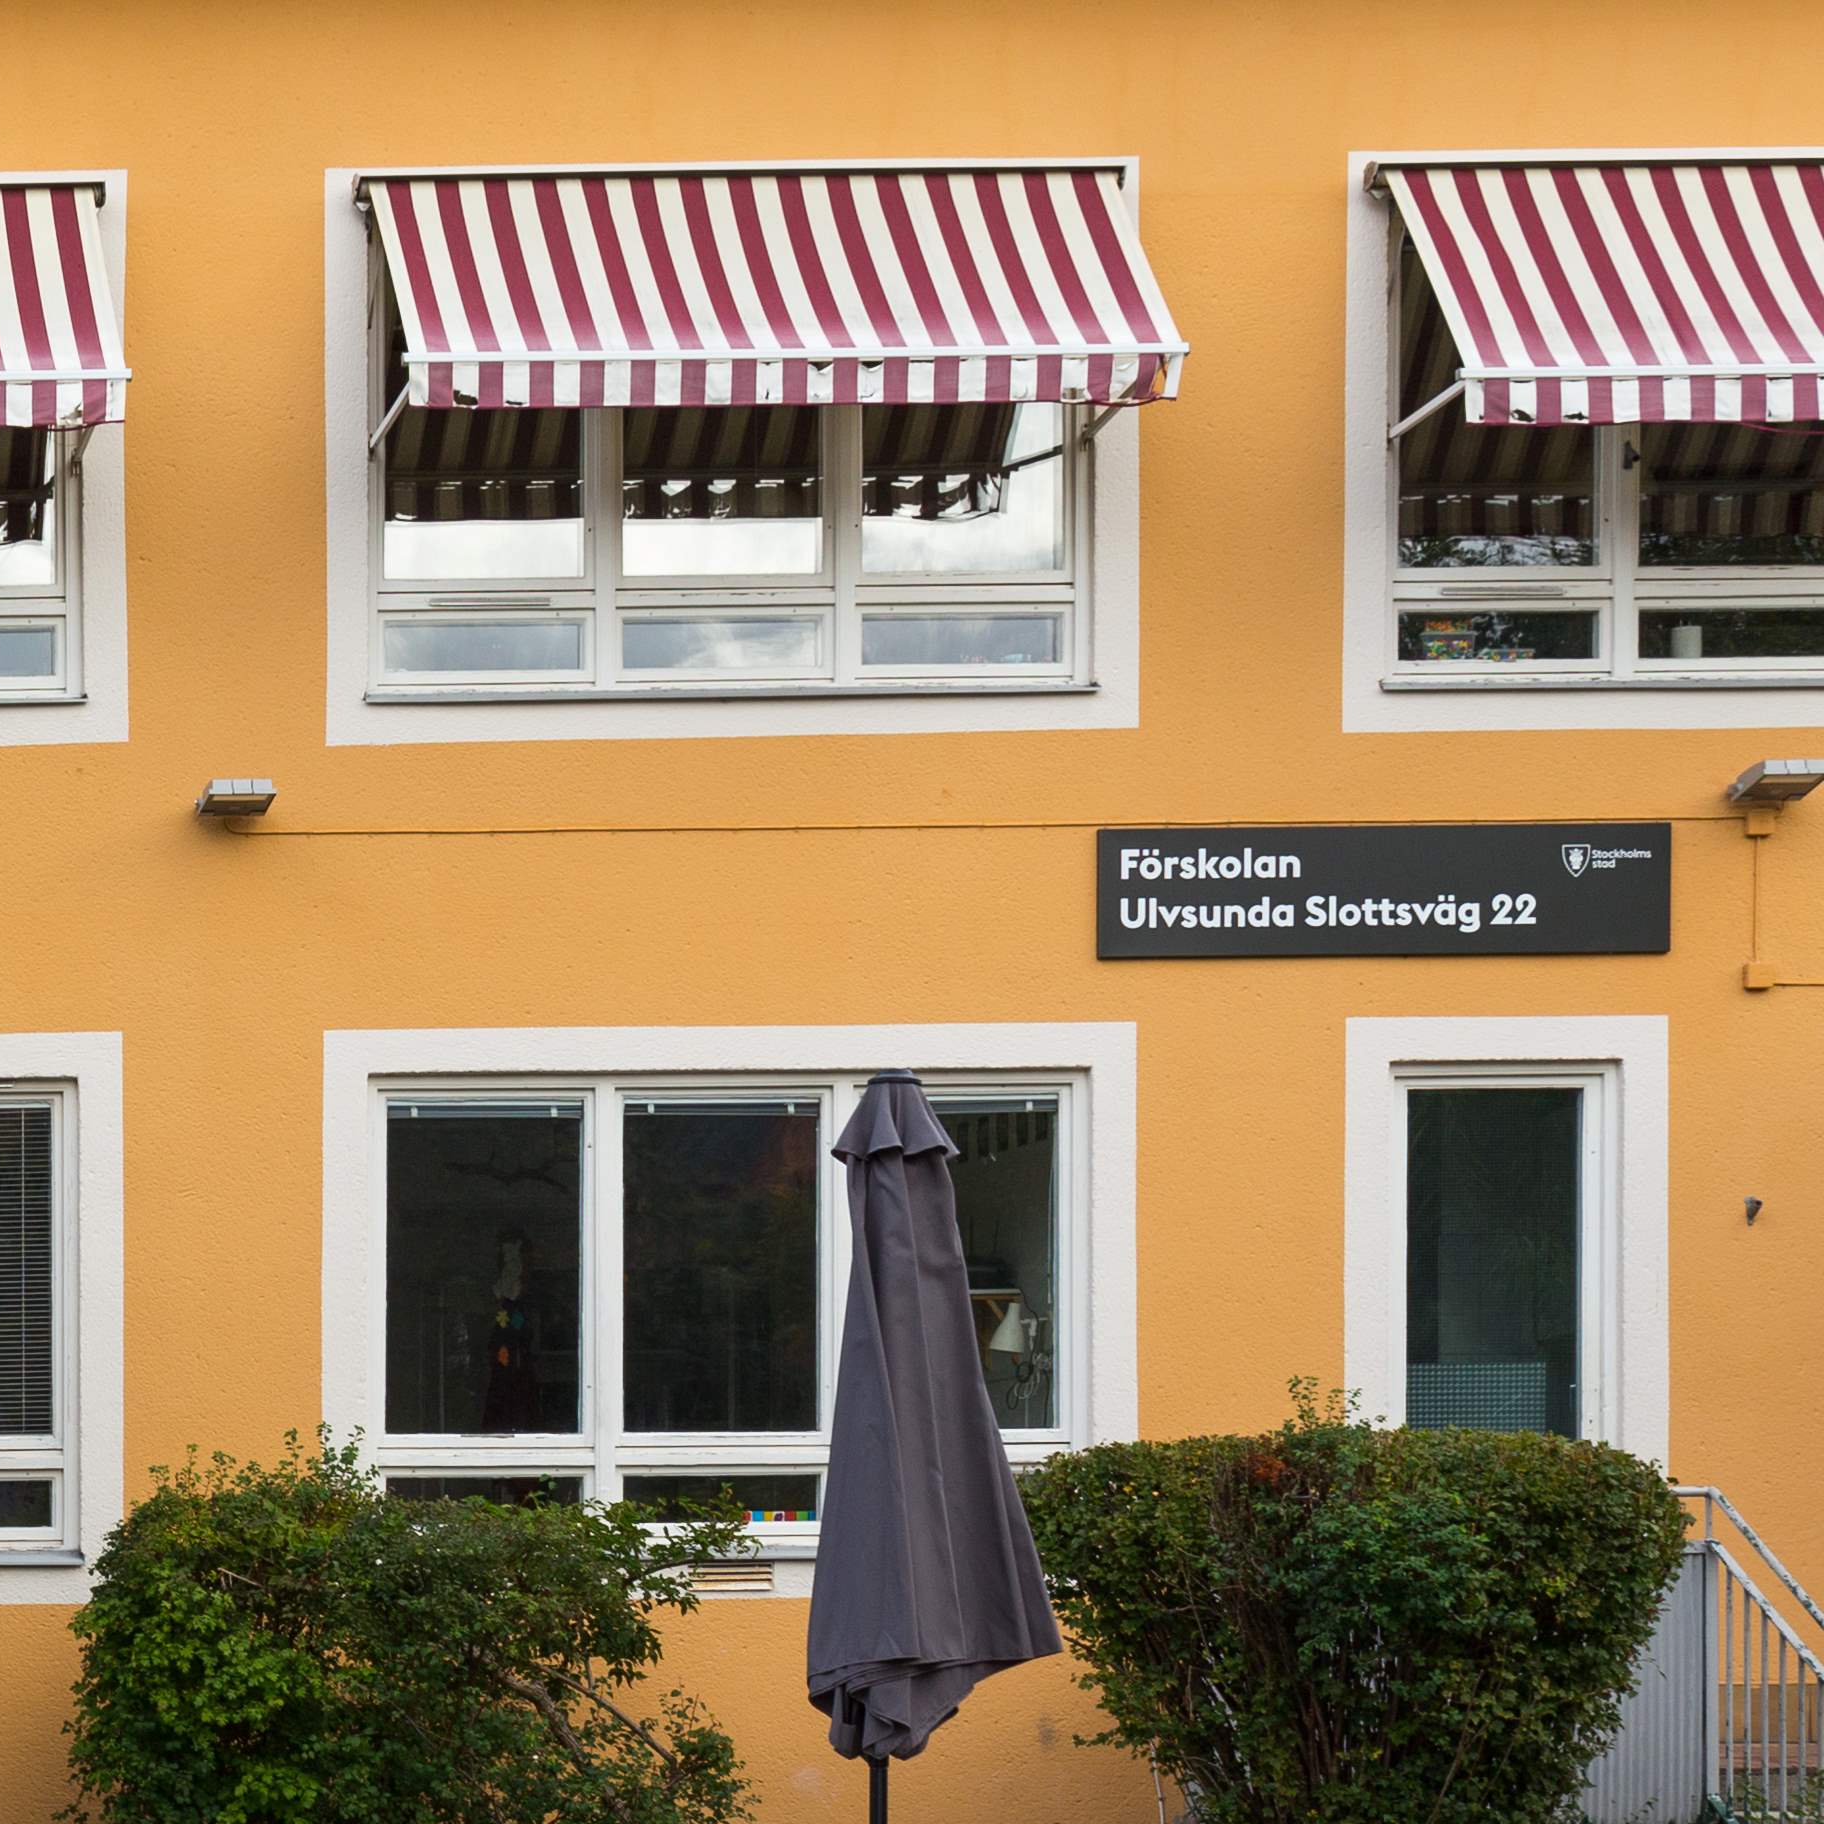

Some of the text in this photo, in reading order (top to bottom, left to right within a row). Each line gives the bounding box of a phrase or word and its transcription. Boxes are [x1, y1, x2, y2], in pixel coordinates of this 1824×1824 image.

[1120, 847, 1301, 880] Förskolan
[1591, 848, 1652, 859] Stockholms
[1592, 858, 1616, 869] stad
[1120, 893, 1537, 933] Ulvsunda Slottsväg 22
